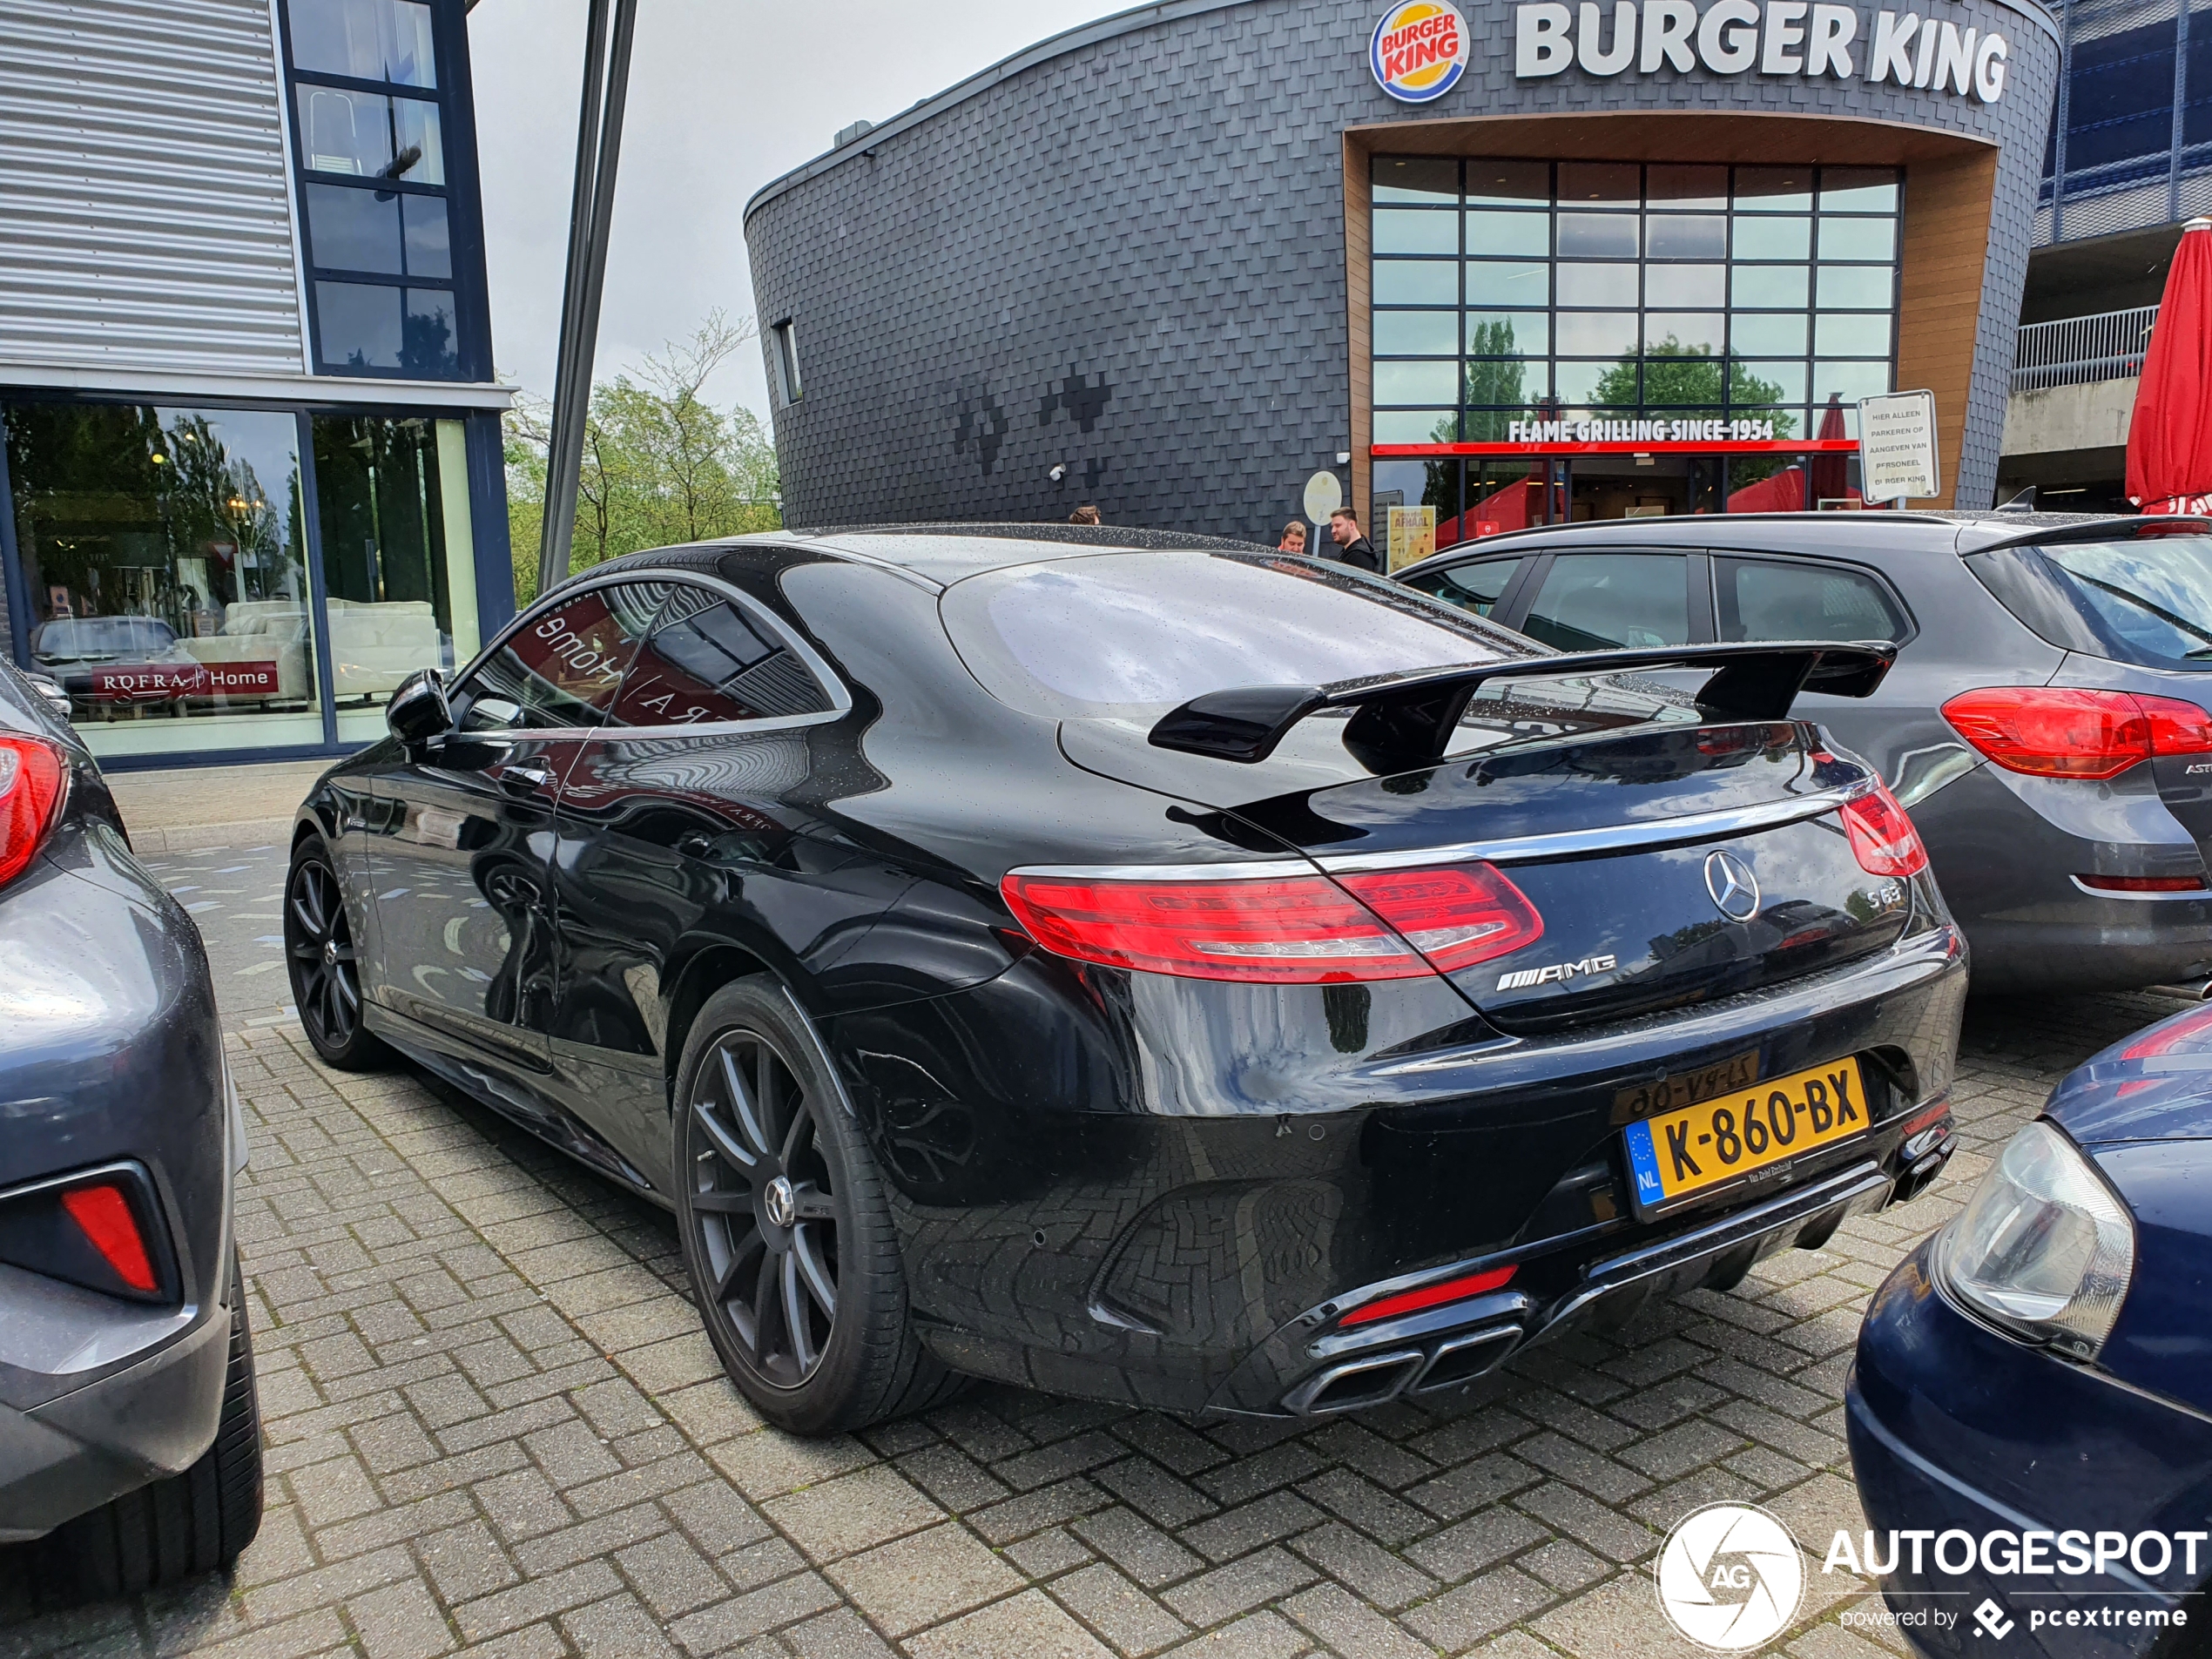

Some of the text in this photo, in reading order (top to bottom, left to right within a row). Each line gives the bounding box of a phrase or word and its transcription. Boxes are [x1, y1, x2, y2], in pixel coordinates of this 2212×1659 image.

[1382, 14, 1455, 56] BURGER
[1385, 31, 1459, 82] KING
[1515, 0, 2007, 103] BURGER KING
[1892, 410, 1920, 419] ALLEEN
[1509, 419, 1773, 442] FLAME GRILLING SINCE 1954
[1871, 428, 1911, 437] PARKEREN
[1870, 444, 1910, 454] AANGEVEN
[1394, 516, 1428, 528] AFHAAL
[103, 671, 268, 692] ROFRA Home
[1536, 954, 1617, 985] AMG
[1637, 1069, 1858, 1191] NL K-860-BX
